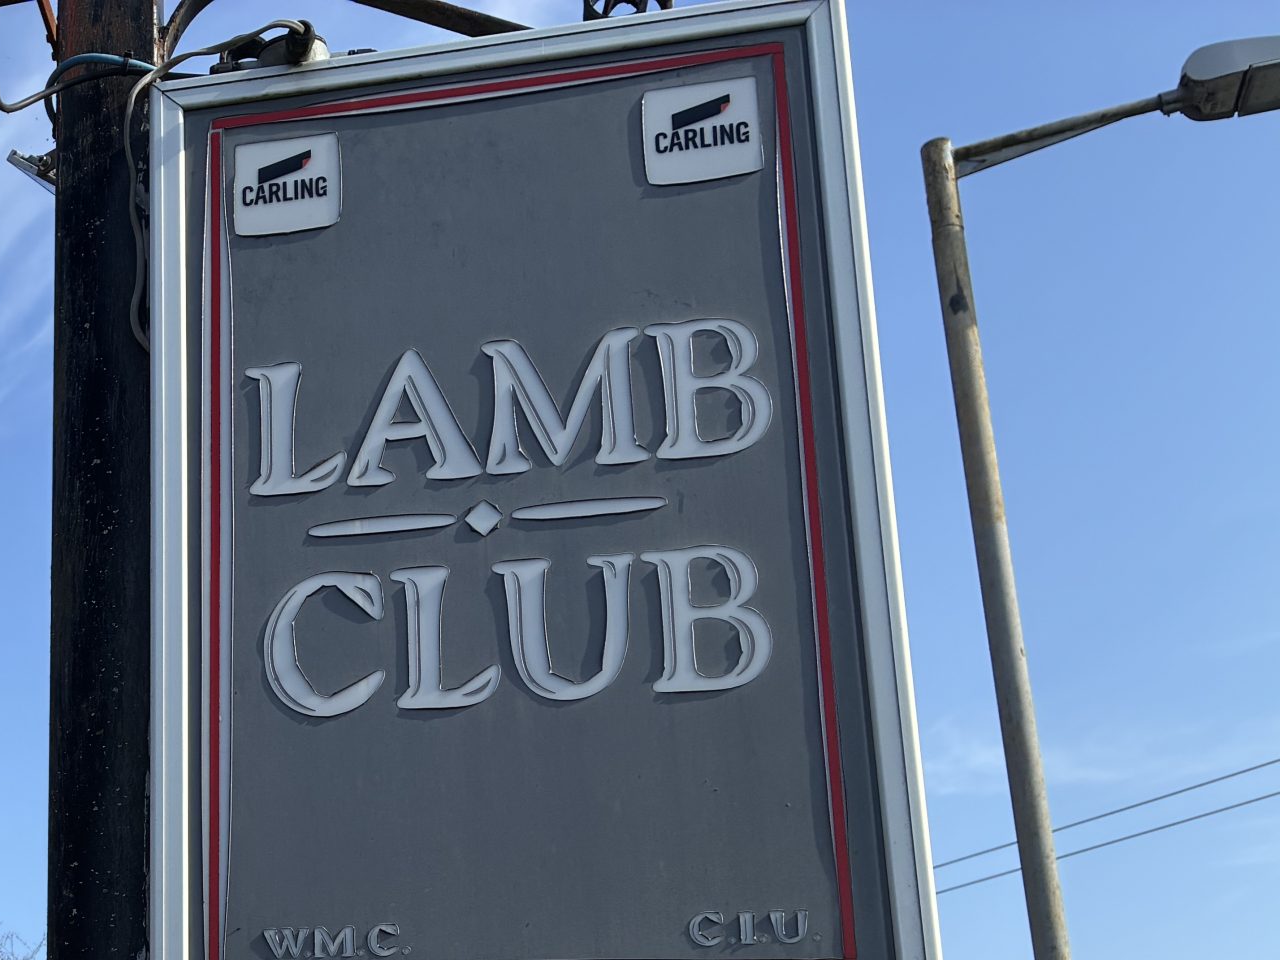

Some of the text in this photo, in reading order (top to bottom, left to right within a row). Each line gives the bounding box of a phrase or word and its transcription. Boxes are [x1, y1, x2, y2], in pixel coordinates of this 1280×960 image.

[654, 121, 750, 154] CARLING
[242, 176, 328, 207] CARLING
[244, 317, 774, 496] LAMB
[263, 543, 774, 718] CLUB
